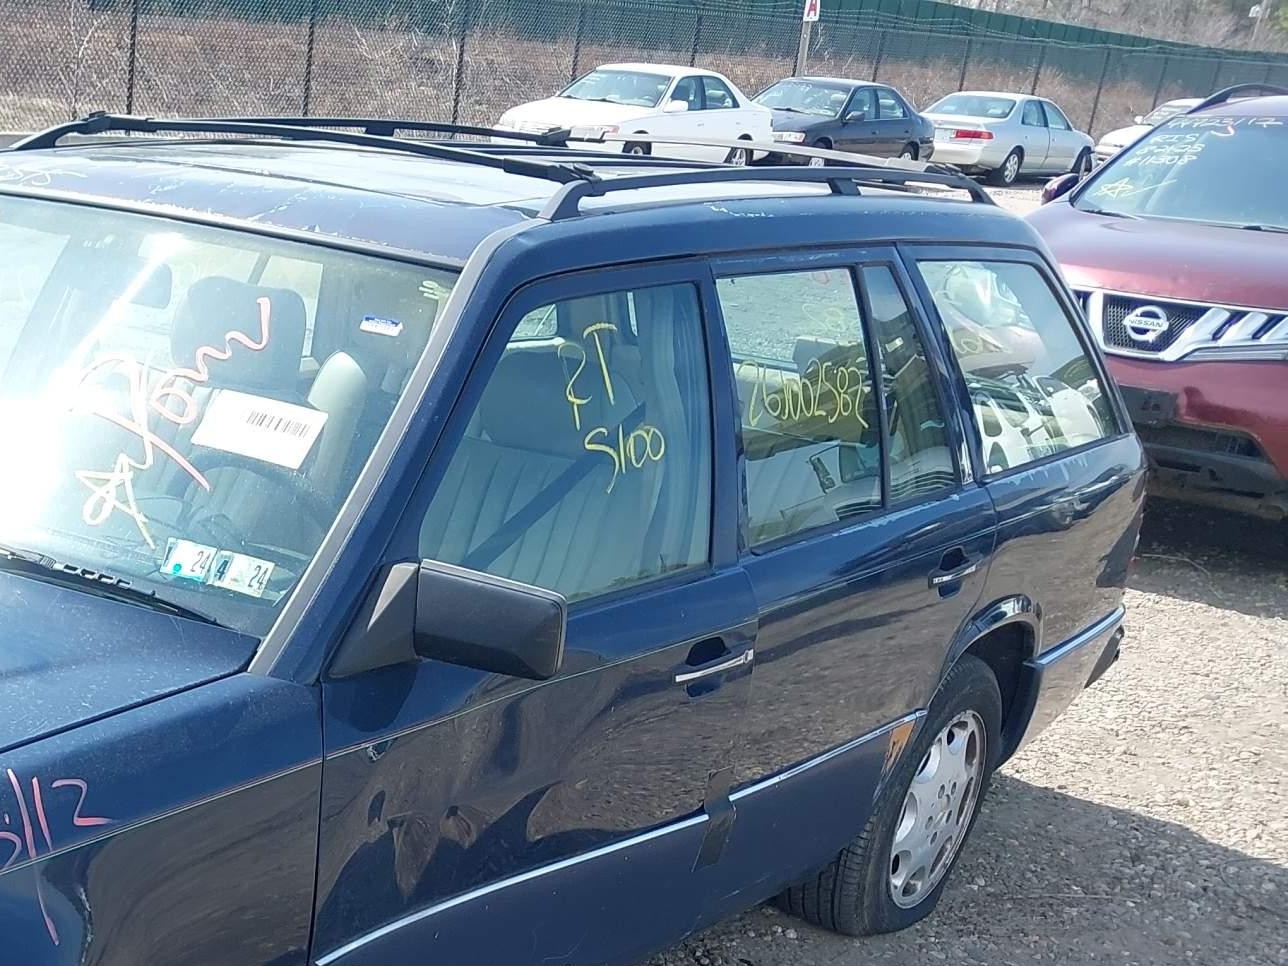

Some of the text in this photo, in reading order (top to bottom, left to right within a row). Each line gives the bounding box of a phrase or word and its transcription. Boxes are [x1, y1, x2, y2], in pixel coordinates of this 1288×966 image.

[1128, 318, 1164, 329] NISSAN
[189, 549, 212, 575] 24
[247, 564, 270, 591] 24
